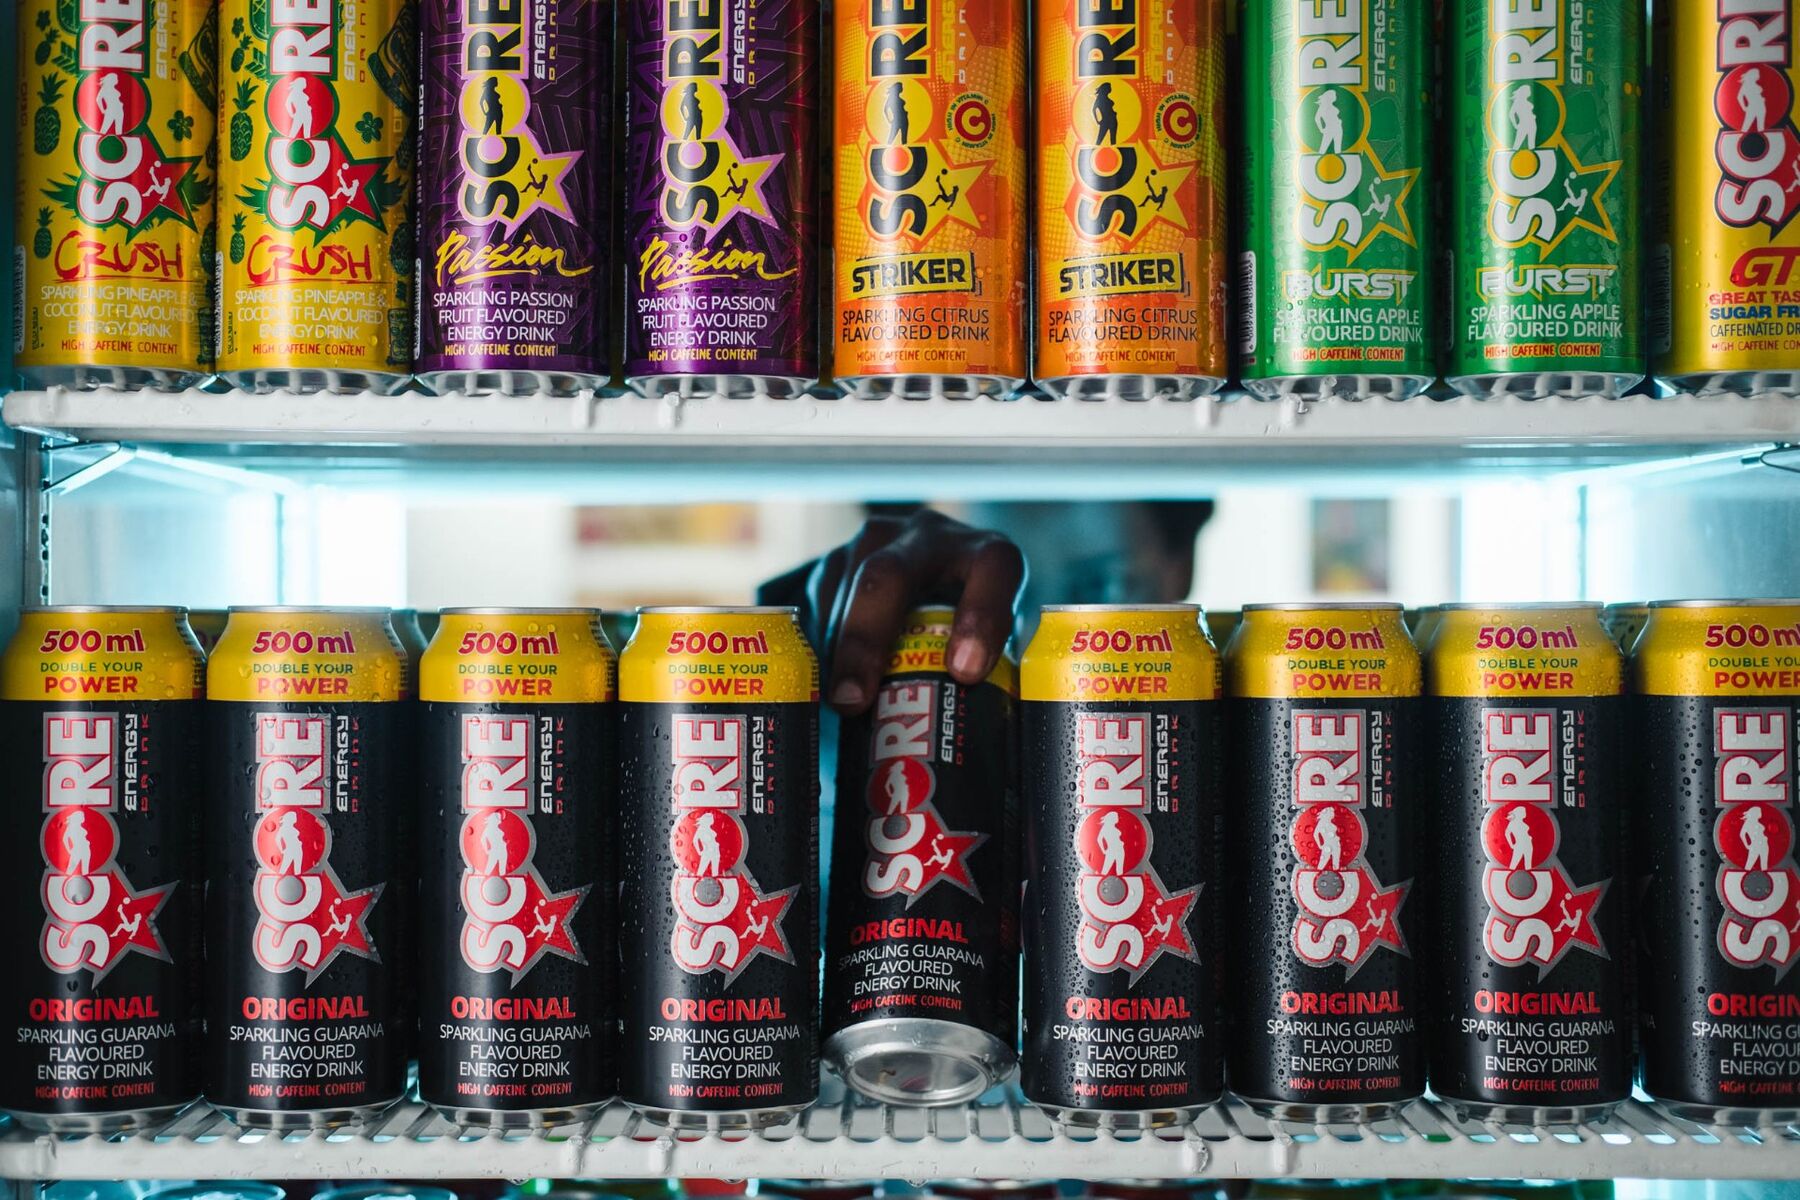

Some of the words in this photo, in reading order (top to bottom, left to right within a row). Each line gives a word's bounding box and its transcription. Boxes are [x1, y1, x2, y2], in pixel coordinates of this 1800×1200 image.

[1300, 0, 1362, 245] SCORE
[1494, 0, 1557, 243] SCORE
[54, 231, 183, 280] CRUSH
[247, 235, 372, 284] CRUSH
[435, 230, 593, 286] Passion
[639, 235, 798, 291] Passion
[853, 258, 966, 293] STRIKER
[1060, 258, 1176, 294] STRIKER
[1481, 268, 1614, 296] BURST
[1287, 270, 1414, 300] BURST
[305, 290, 375, 304] PINEAPPLE
[434, 291, 507, 307] SPARKLING
[511, 292, 573, 308] PASSION
[638, 296, 707, 312] SPARKLING
[712, 297, 775, 311] PASSION
[1709, 290, 1766, 305] GREAT
[301, 307, 383, 324] FLAVOURED
[439, 310, 473, 324] FRUIT
[477, 309, 566, 325] FLAVOURED
[843, 307, 925, 325] SPARKLING
[931, 307, 989, 324] CITRUS
[1049, 307, 1139, 326] SPARKLING
[1143, 307, 1198, 324] CITRUS
[1276, 308, 1373, 325] SPARKLING
[1376, 308, 1419, 325] APPLE
[1471, 304, 1566, 322] SPARKLING
[1570, 304, 1620, 320] APPLE
[1710, 305, 1772, 319] SUGAR
[643, 314, 674, 329] FRUIT
[682, 314, 767, 329] FLAVOURED
[1711, 322, 1783, 337] CAFFEINATED
[316, 325, 358, 340] DRINK
[448, 326, 502, 341] ENERGY
[507, 327, 554, 341] DRINK
[651, 331, 704, 346] ENERGY
[709, 331, 756, 346] DRINK
[842, 325, 931, 343] FLAVOURED
[938, 325, 989, 341] DRINK
[1049, 324, 1142, 343] FLAVOURED
[1148, 325, 1198, 341] DRINK
[1379, 326, 1422, 343] DRINK
[1468, 322, 1571, 340] FLAVOURED
[1575, 322, 1623, 338] DRINK
[445, 343, 466, 356] HIGH
[469, 343, 509, 356] CAFFEINE
[514, 344, 556, 357] CONTENT
[1293, 348, 1316, 361] HIGH
[1319, 347, 1363, 361] CAFFEINE
[1367, 348, 1405, 361] CONTENT
[1484, 344, 1508, 358] HIGH
[1511, 343, 1555, 357] CAFFEINE
[1559, 343, 1601, 356] CONTENT
[1738, 341, 1780, 351] CAFFEINE
[40, 630, 102, 654] 500
[106, 628, 145, 653] ml
[251, 630, 314, 655] 500
[317, 629, 356, 654] ml
[667, 631, 728, 655] 500
[732, 630, 769, 654] ml
[1285, 627, 1346, 651] 500
[1350, 626, 1384, 650] ml
[1475, 626, 1538, 650] 500
[1542, 625, 1579, 649] ml
[1705, 624, 1770, 648] 500
[41, 662, 97, 672] DOUBLE
[103, 662, 142, 672] YOUR
[253, 664, 309, 674] DOUBLE
[314, 663, 353, 673] YOUR
[669, 664, 724, 674] DOUBLE
[730, 664, 768, 674] YOUR
[1288, 659, 1345, 669] DOUBLE
[1350, 659, 1385, 669] YOUR
[1479, 658, 1533, 668] DOUBLE
[1539, 658, 1578, 668] YOUR
[1709, 657, 1769, 668] DOUBLE
[45, 676, 138, 693] POWER
[258, 678, 348, 695] POWER
[674, 678, 763, 695] POWER
[1293, 673, 1381, 690] POWER
[1483, 672, 1574, 689] POWER
[941, 684, 956, 763] ENERGY
[125, 714, 137, 811] ENERGY
[1157, 715, 1168, 812] ENERGY
[1563, 710, 1574, 807] ENERGY
[866, 683, 932, 894] SCORE
[48, 718, 112, 967] SCORE
[260, 719, 323, 968] SCORE
[466, 720, 527, 968] SCORE
[677, 720, 741, 969] SCORE
[1083, 719, 1145, 968] SCORE
[1298, 715, 1360, 962] SCORE
[1490, 715, 1553, 963] SCORE
[1720, 714, 1789, 963] SCORE
[849, 918, 968, 945] ORIGINAL
[912, 944, 984, 969] GUARANA
[865, 960, 953, 978] FLAVOURED
[854, 977, 909, 996] ENERGY
[913, 976, 961, 994] DRINK
[30, 996, 159, 1022] ORIGINAL
[242, 996, 369, 1020] ORIGINAL
[661, 996, 786, 1021] ORIGINAL
[875, 995, 917, 1009] CAFFEINE
[921, 996, 962, 1011] CONTENT
[1065, 996, 1191, 1021] ORIGINAL
[1474, 991, 1601, 1015] ORIGINAL
[17, 1027, 97, 1044] SPARKLING
[101, 1024, 176, 1043] GUARANA
[649, 1026, 729, 1043] SPARKLING
[733, 1025, 800, 1043] GUARANA
[1462, 1018, 1544, 1037] SPARKLING
[1548, 1020, 1614, 1037] GUARANA
[49, 1045, 144, 1062] FLAVOURED
[683, 1046, 773, 1061] FLAVOURED
[1497, 1039, 1589, 1055] FLAVOURED
[38, 1064, 99, 1080] ENERGY
[104, 1062, 153, 1079] DRINK
[671, 1063, 732, 1079] ENERGY
[736, 1062, 781, 1078] DRINK
[1485, 1056, 1547, 1073] ENERGY
[1552, 1055, 1597, 1072] DRINK
[669, 1084, 693, 1097] HIGH
[696, 1084, 740, 1097] CAFFEINE
[745, 1082, 783, 1096] CONTENT
